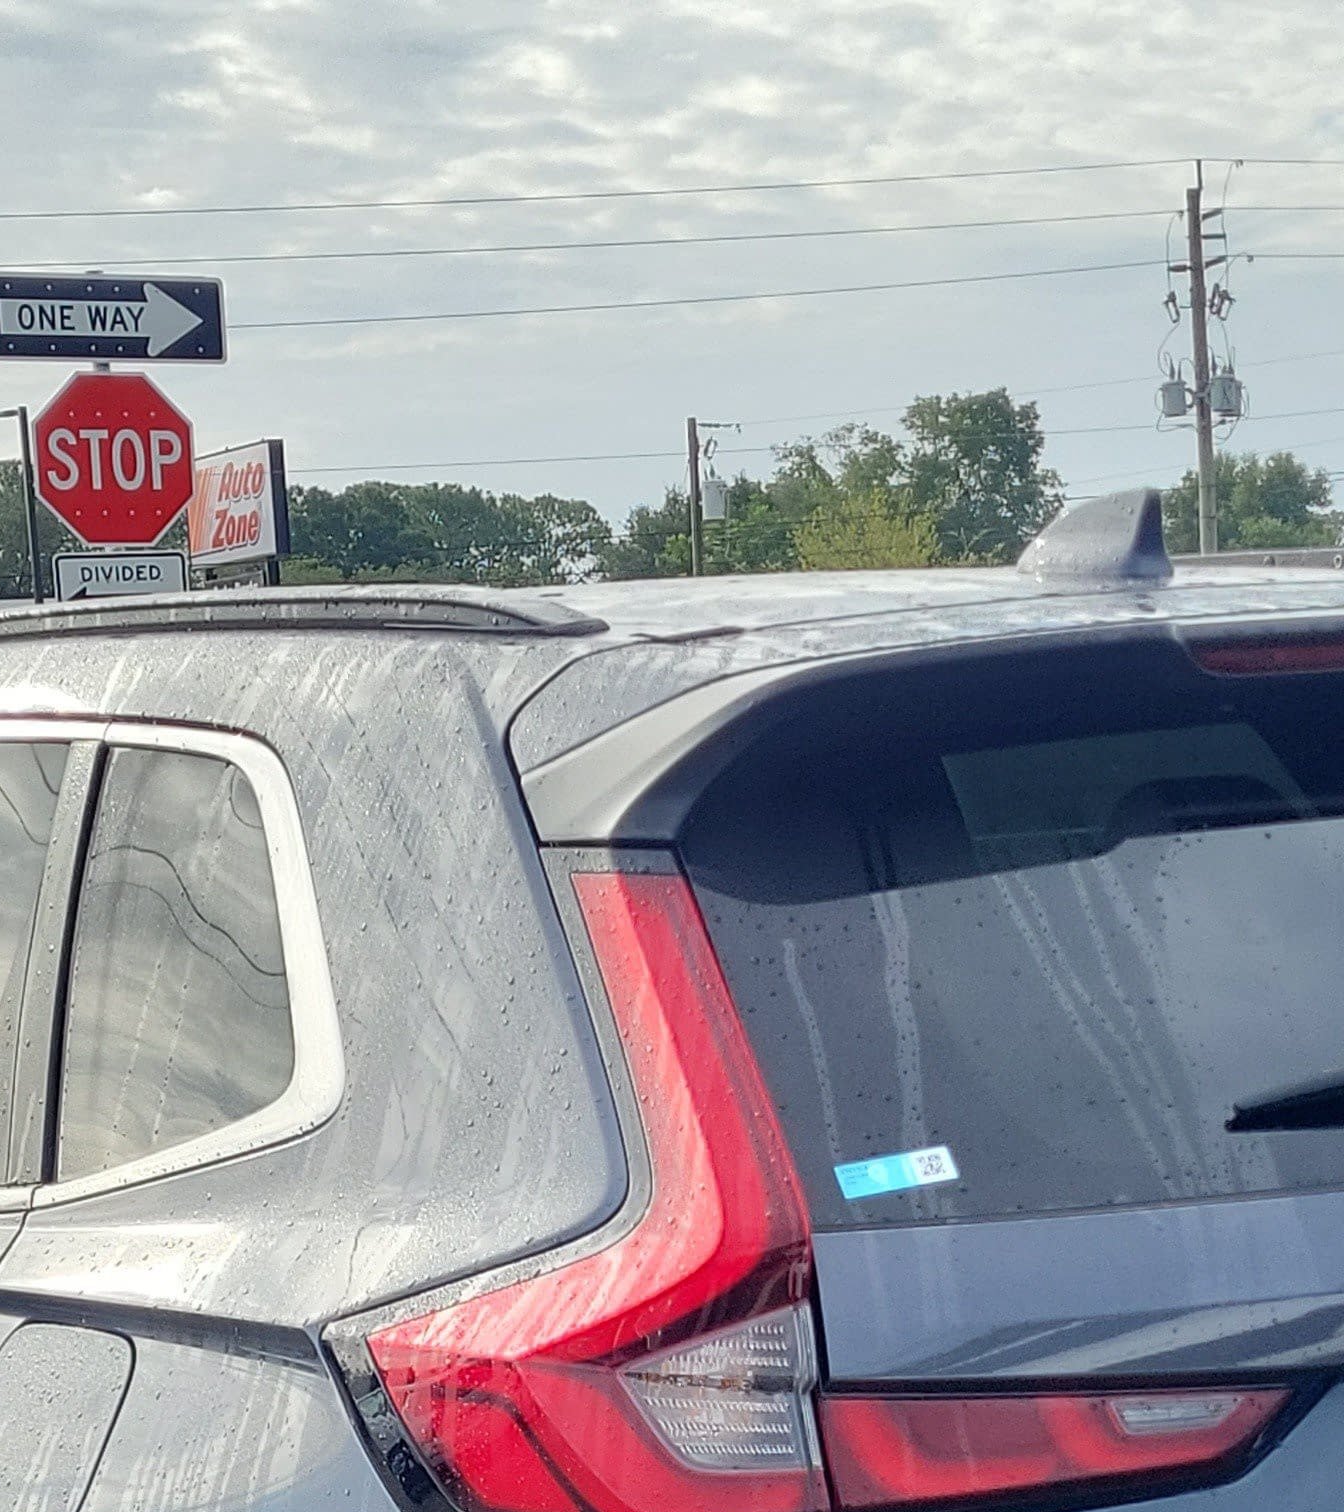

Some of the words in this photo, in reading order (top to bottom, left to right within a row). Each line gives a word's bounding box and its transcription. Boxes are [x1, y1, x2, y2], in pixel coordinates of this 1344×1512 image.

[17, 303, 76, 332] ONE
[87, 305, 145, 333] WAY
[47, 427, 182, 492] STOP
[217, 460, 265, 503] Auto
[211, 508, 261, 549] Zone
[80, 564, 162, 584] DIVIDED
